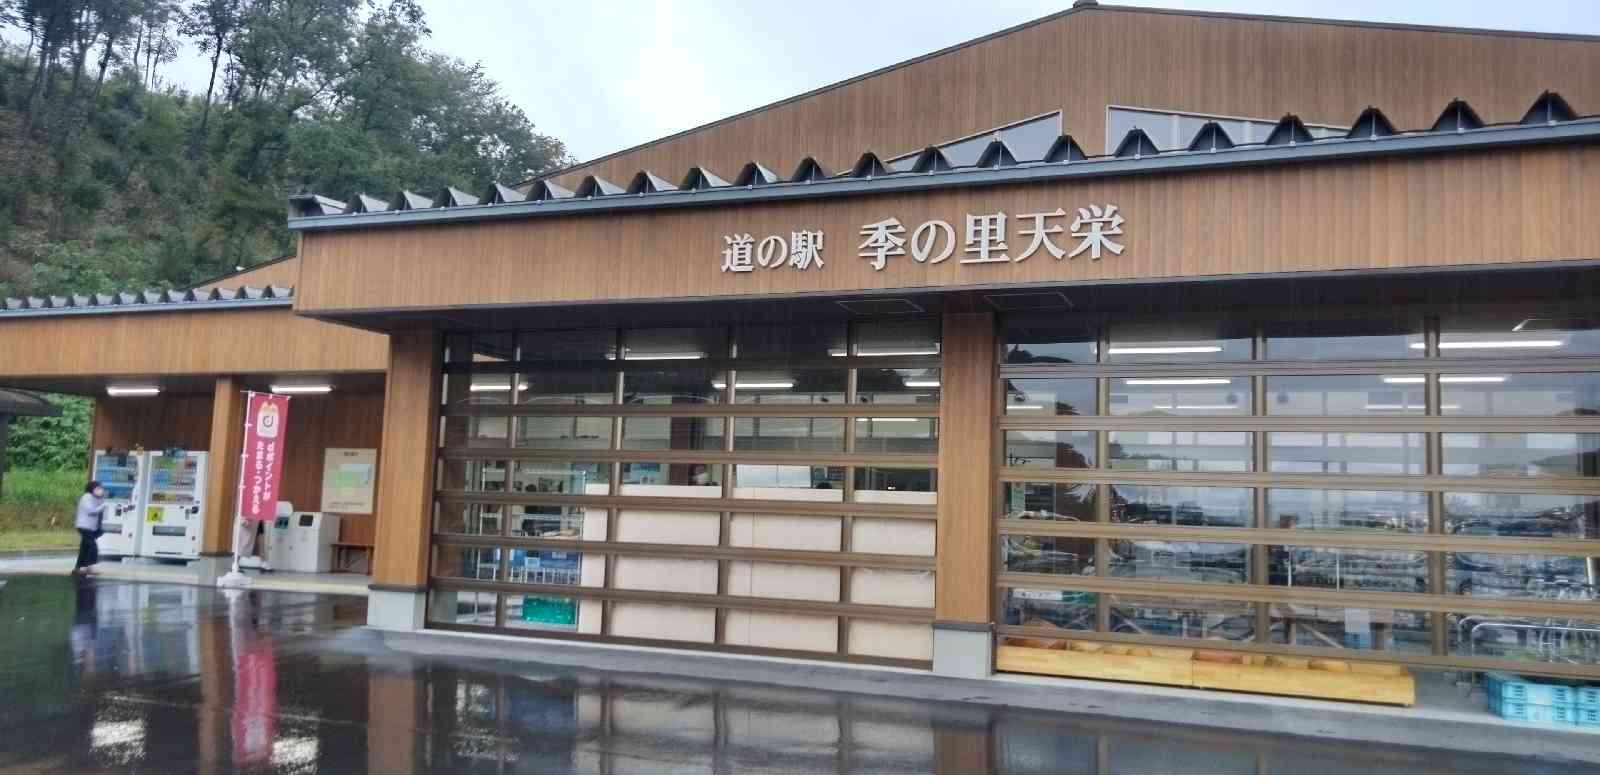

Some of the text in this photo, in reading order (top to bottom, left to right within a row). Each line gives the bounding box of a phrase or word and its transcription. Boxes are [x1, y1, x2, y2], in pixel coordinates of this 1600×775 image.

[721, 203, 1126, 273] 道の駅 季の里天栄
